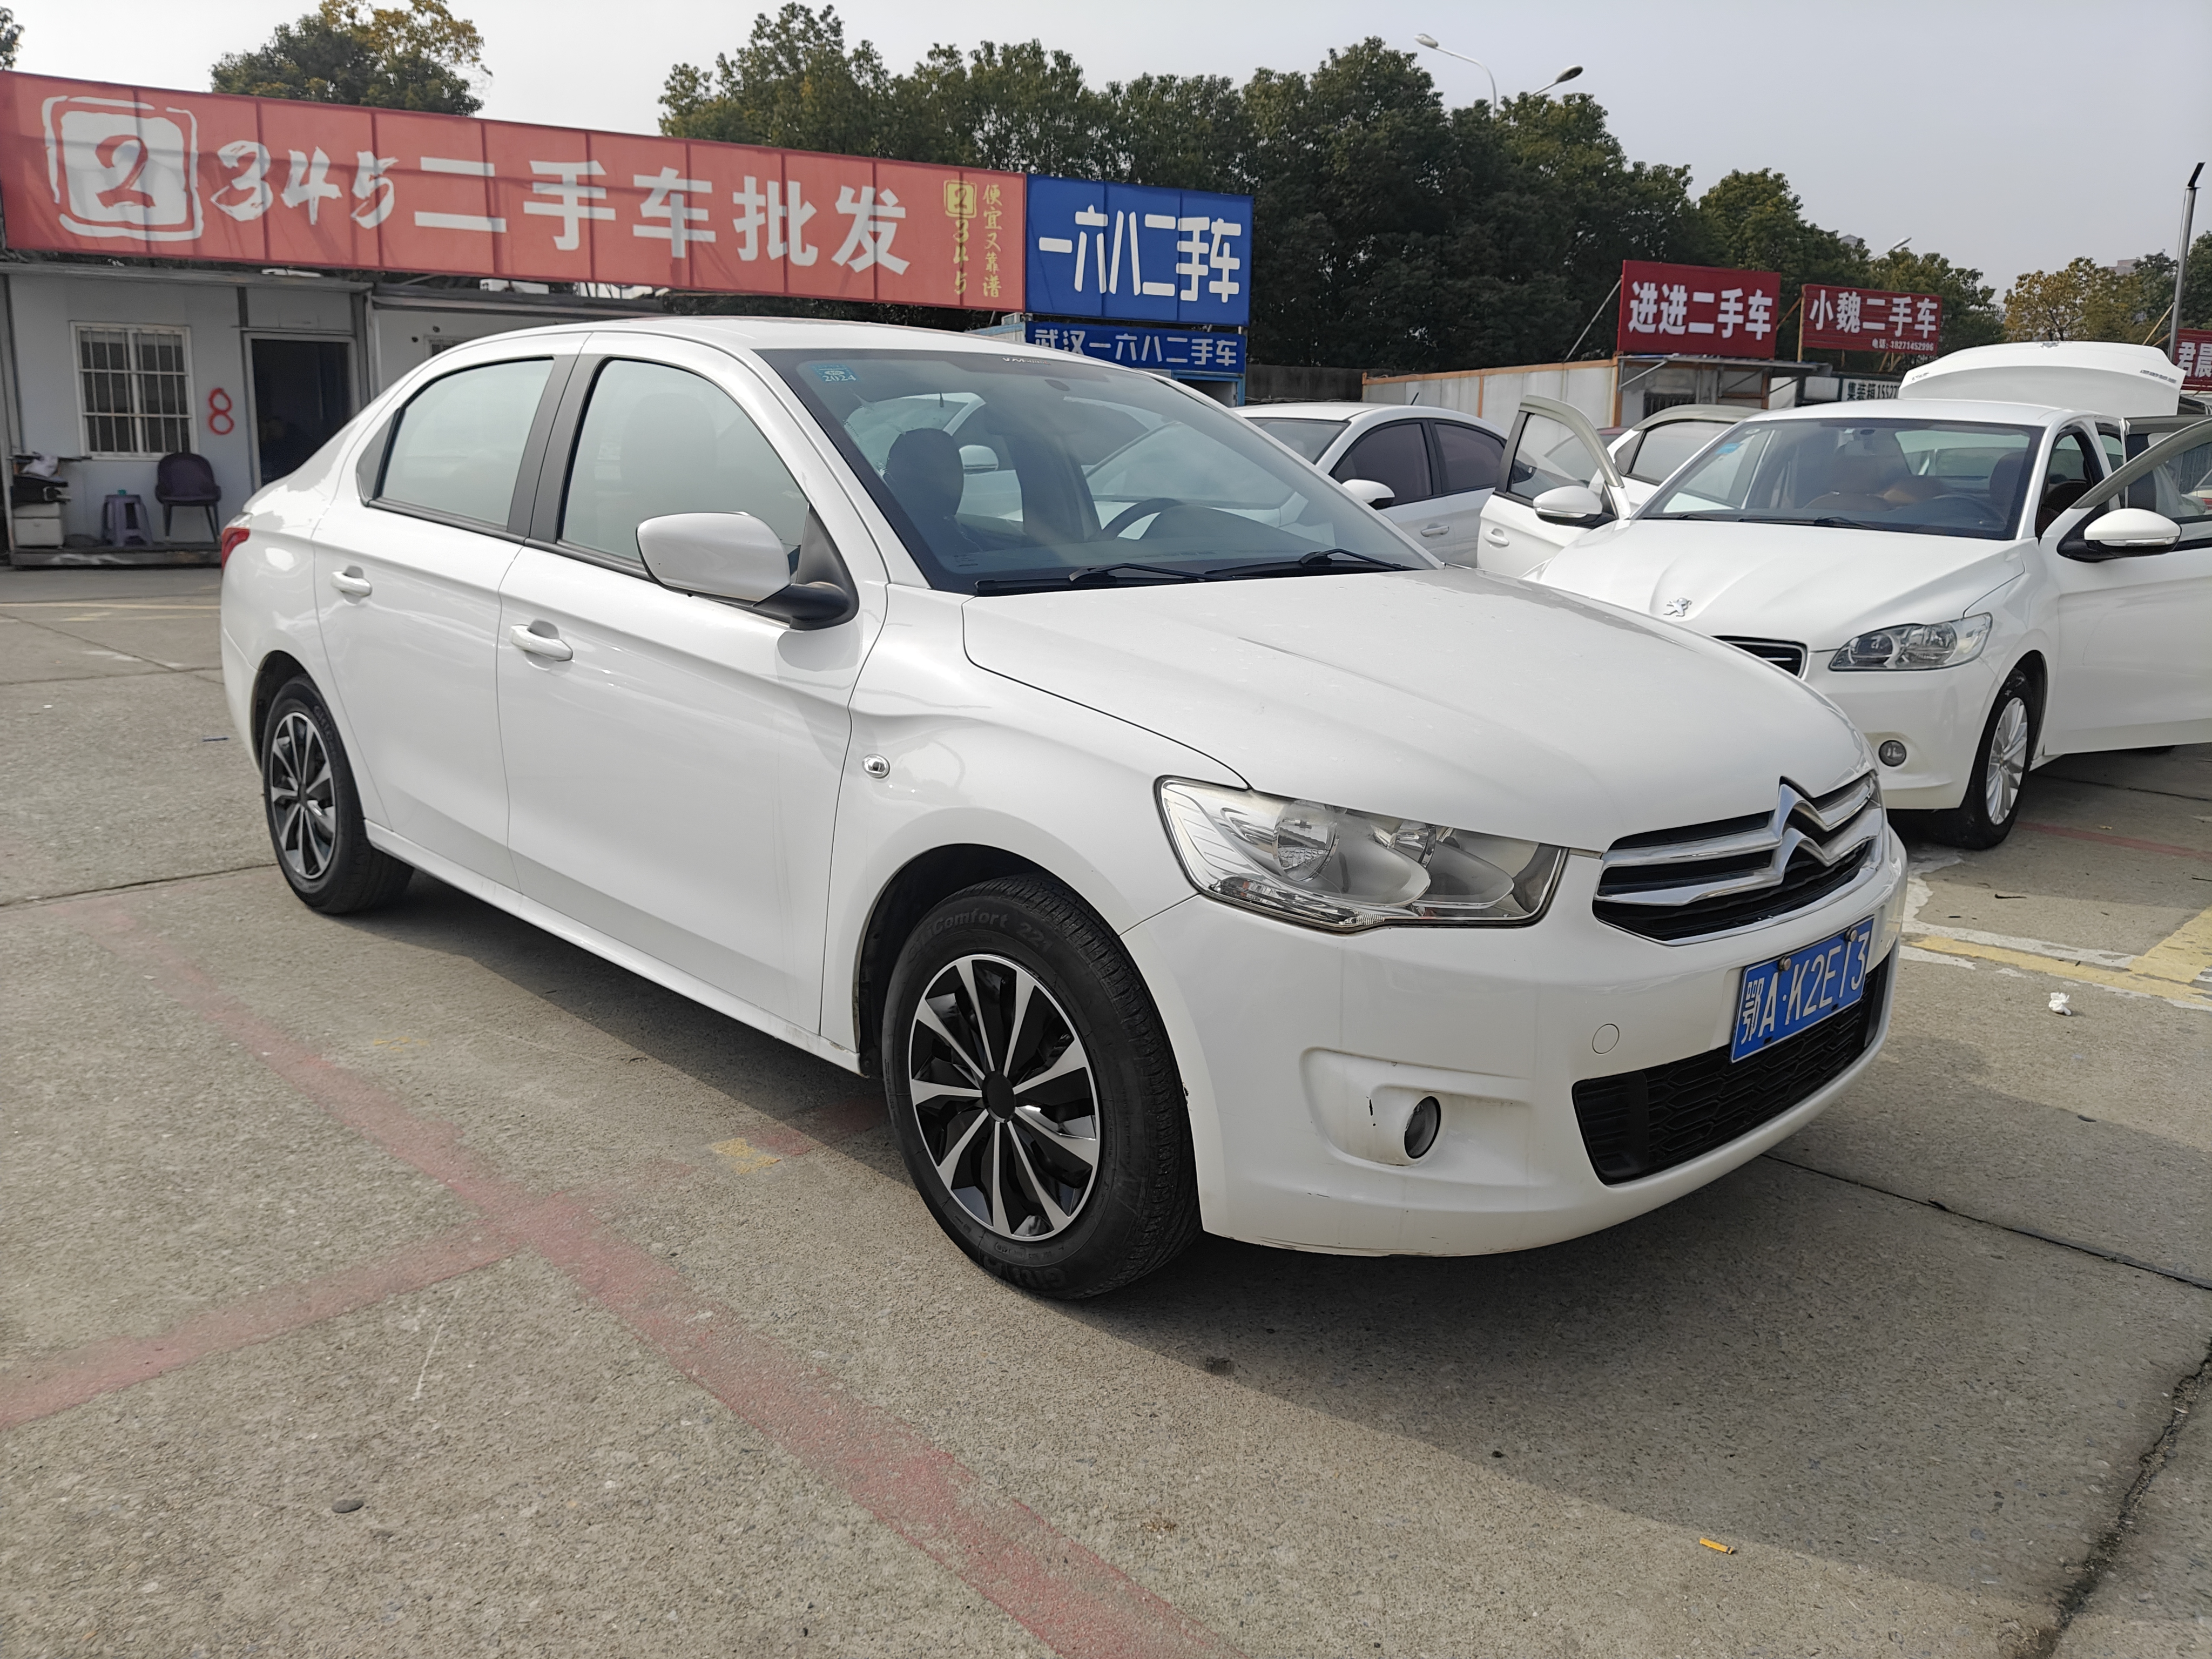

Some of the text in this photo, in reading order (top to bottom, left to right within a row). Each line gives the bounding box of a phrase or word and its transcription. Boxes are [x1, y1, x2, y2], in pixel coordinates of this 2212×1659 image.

[951, 186, 970, 295] 2345
[982, 184, 1003, 298] 便宜又靠谱
[1038, 204, 1242, 304] 一六八二手车
[1628, 281, 1773, 341] 进进二手车
[1809, 288, 1938, 339] 小魏二手车
[1035, 328, 1238, 366] 武汉一六八二手车
[821, 374, 857, 382] 2024
[207, 388, 234, 435] 8
